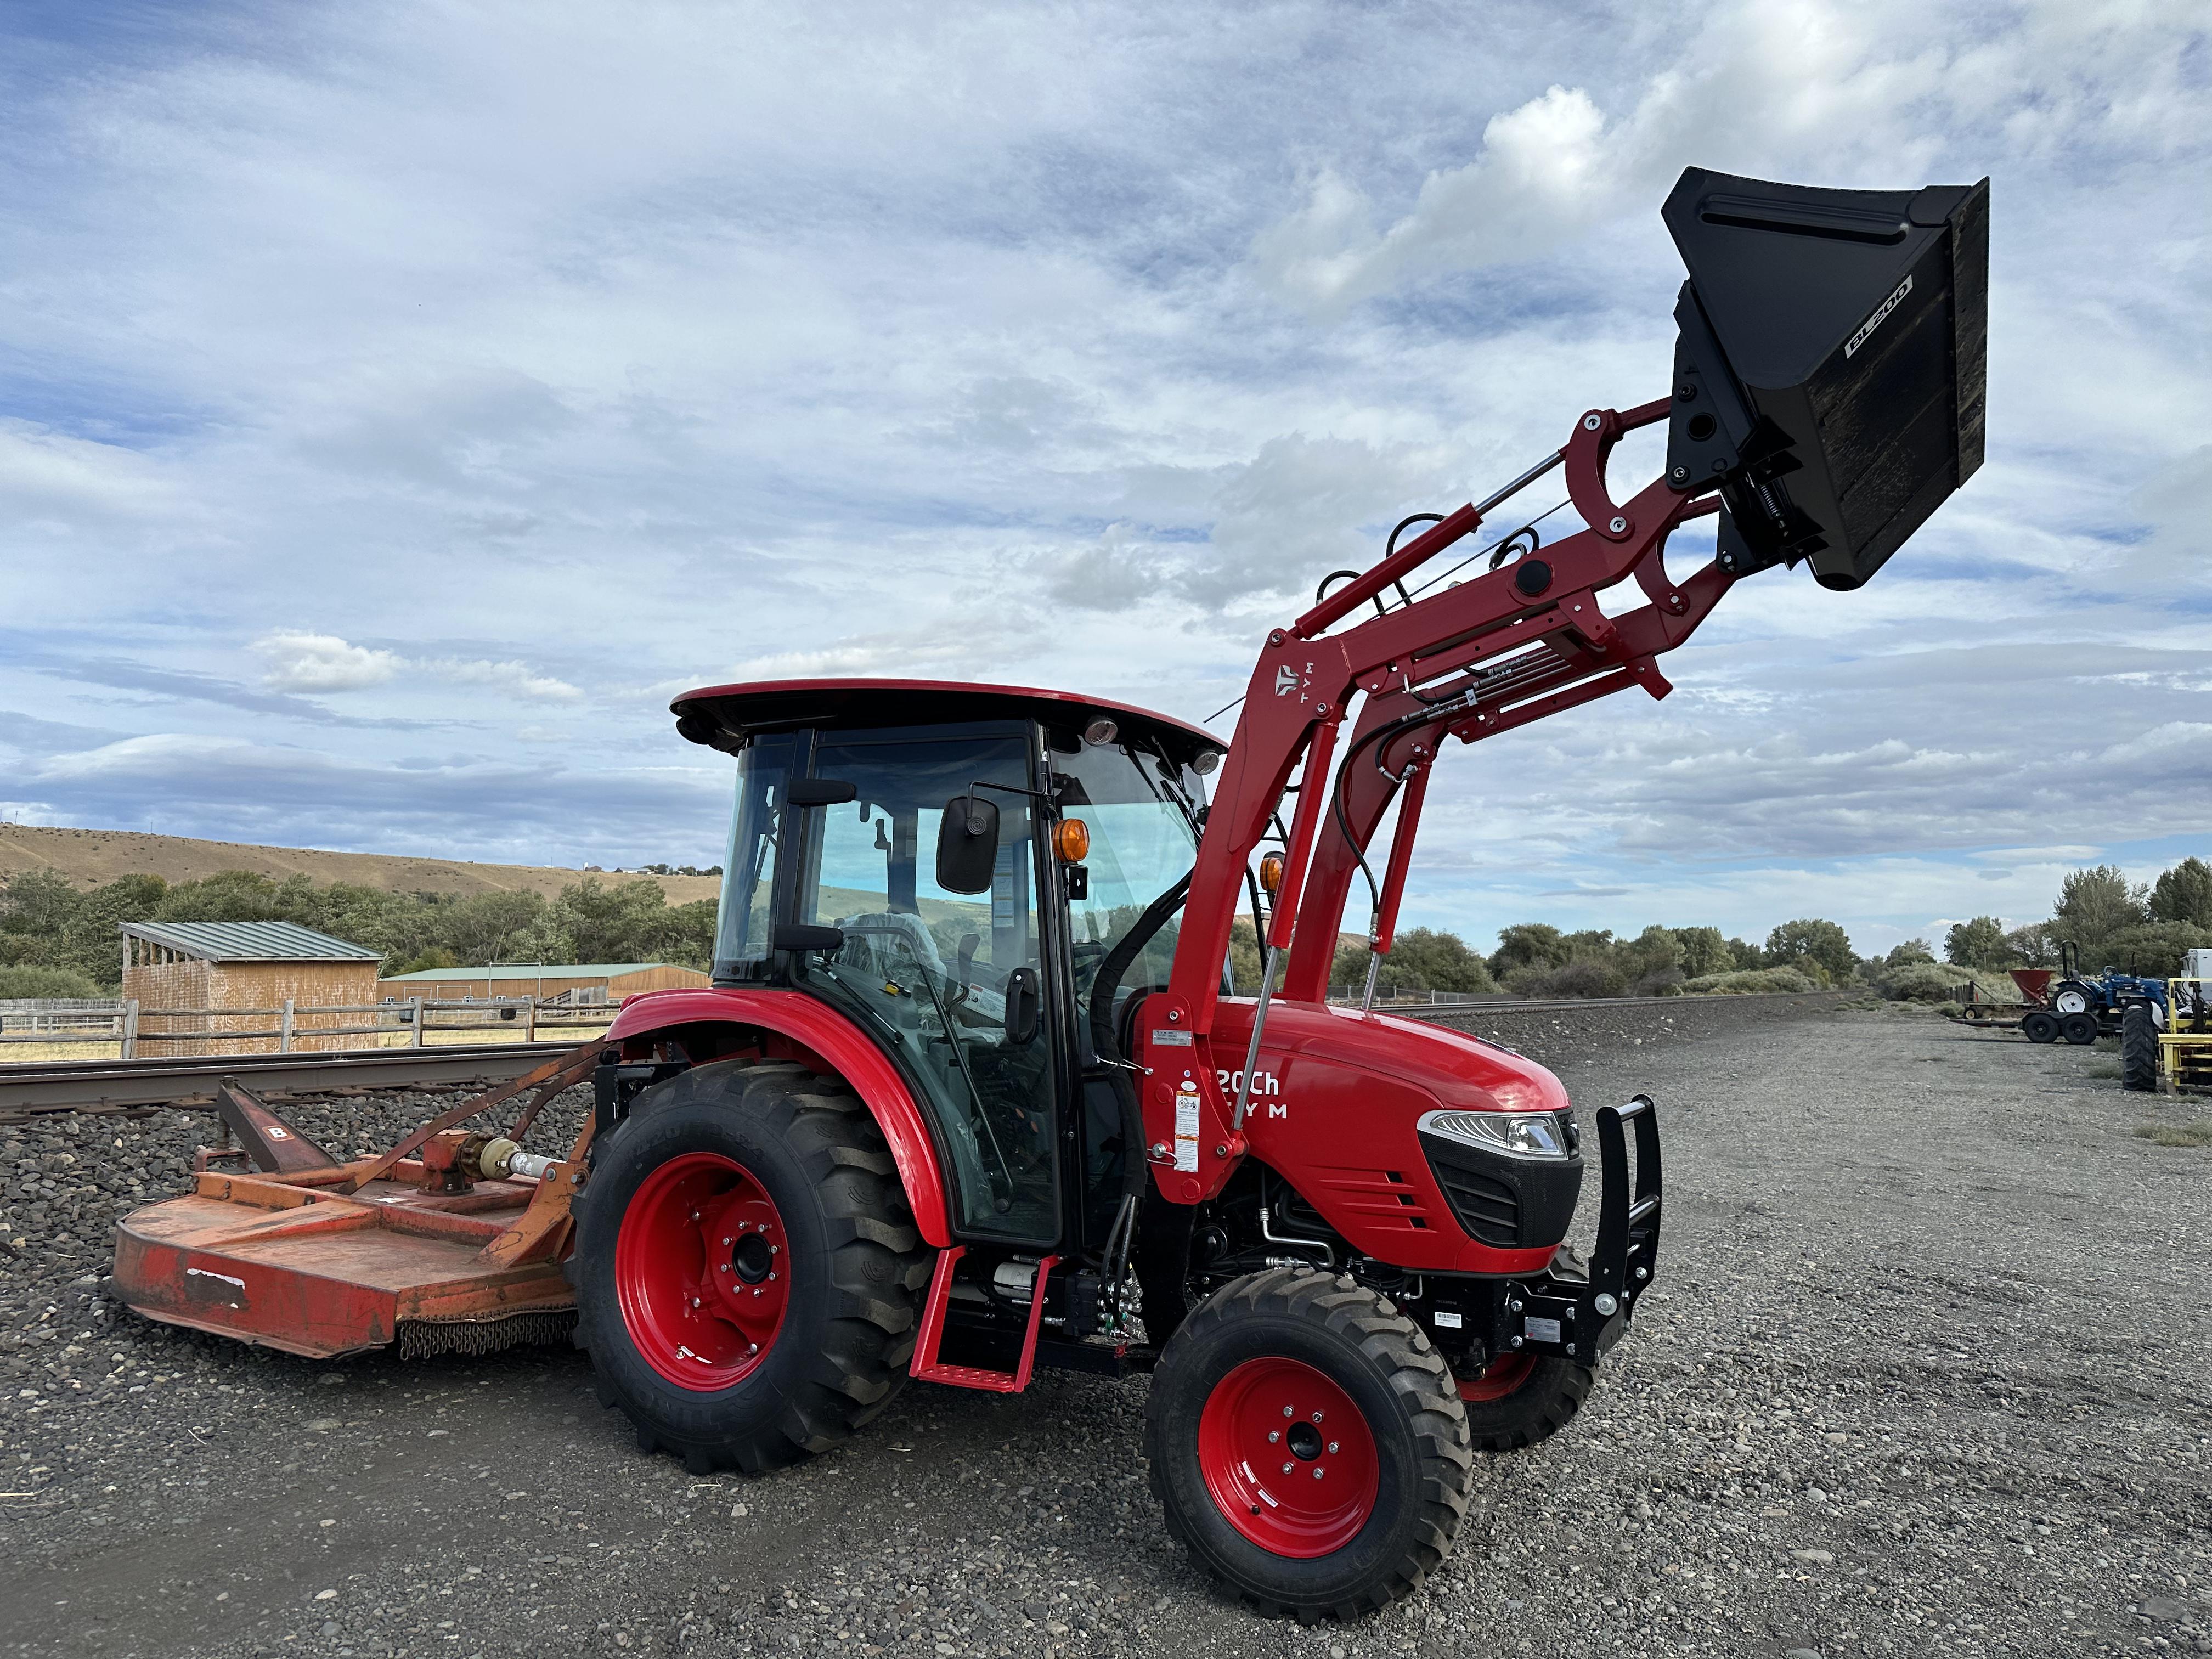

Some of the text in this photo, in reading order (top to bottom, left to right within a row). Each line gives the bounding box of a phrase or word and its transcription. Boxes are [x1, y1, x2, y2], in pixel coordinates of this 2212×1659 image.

[1849, 283, 1908, 352] BL200
[1300, 662, 1314, 703] TYM
[1227, 1101, 1287, 1119] YM
[268, 1127, 287, 1138] B
